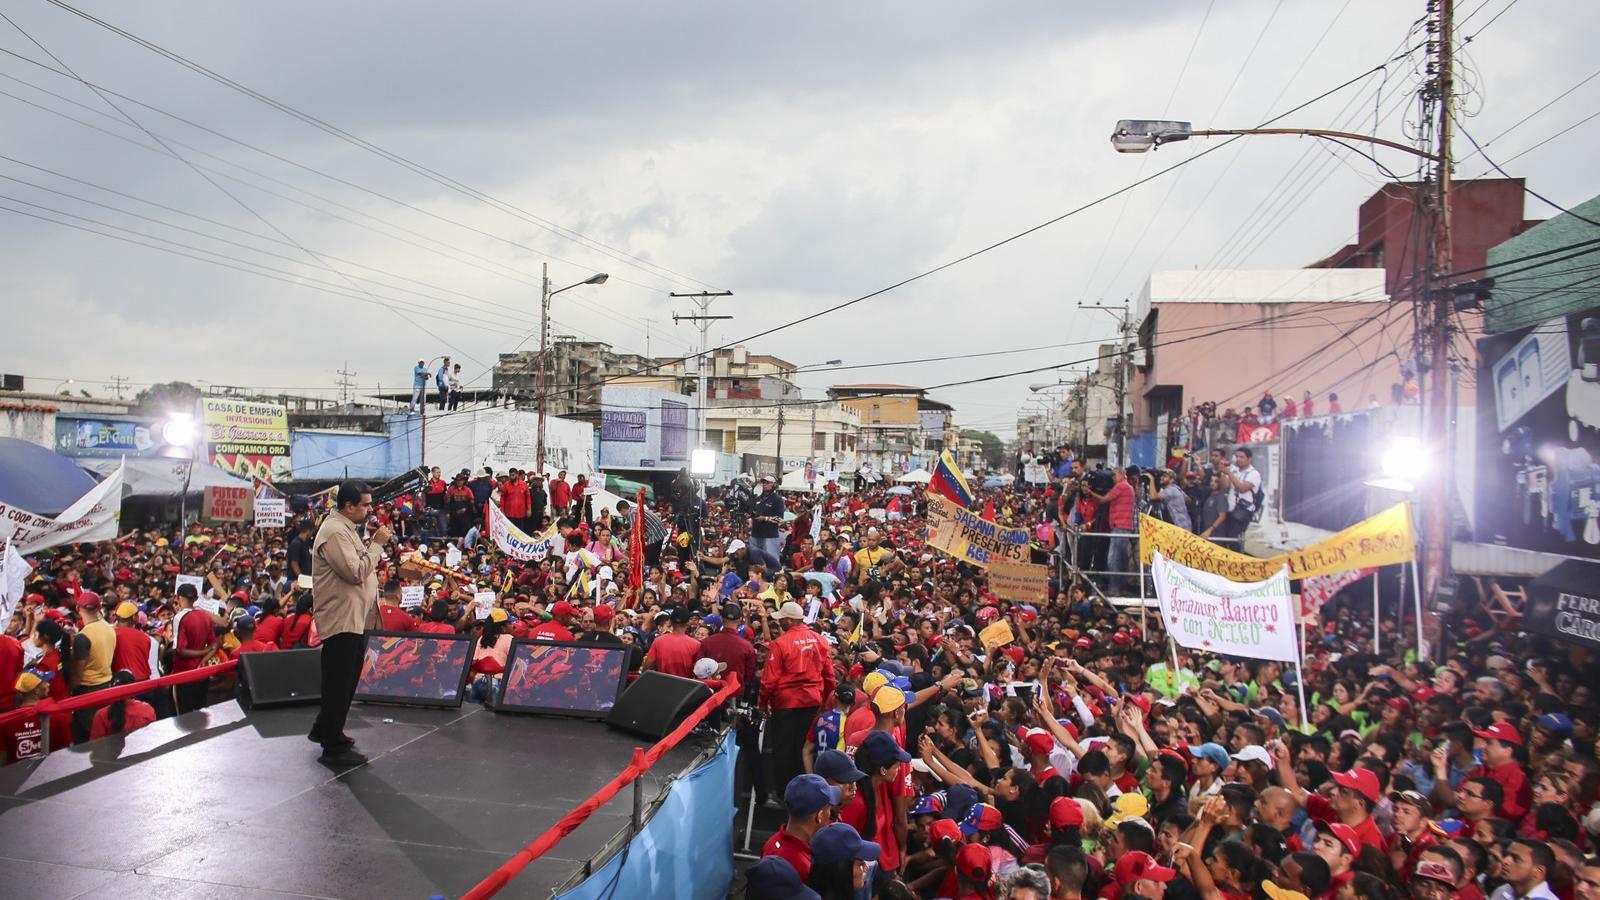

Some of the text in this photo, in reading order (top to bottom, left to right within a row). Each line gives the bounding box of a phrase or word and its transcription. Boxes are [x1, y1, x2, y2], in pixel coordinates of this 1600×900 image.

[207, 403, 283, 418] CASA DE EMPEÑO
[613, 413, 642, 423] PALACIO
[226, 416, 273, 425] INVERSIONES
[215, 445, 268, 454] COMPRAMOS
[8, 509, 32, 525] COOP.
[211, 506, 239, 518] NICO
[953, 507, 995, 538] SABANA
[960, 526, 1022, 560] PRESENTES
[1183, 617, 1205, 637] con
[818, 729, 828, 755] 9
